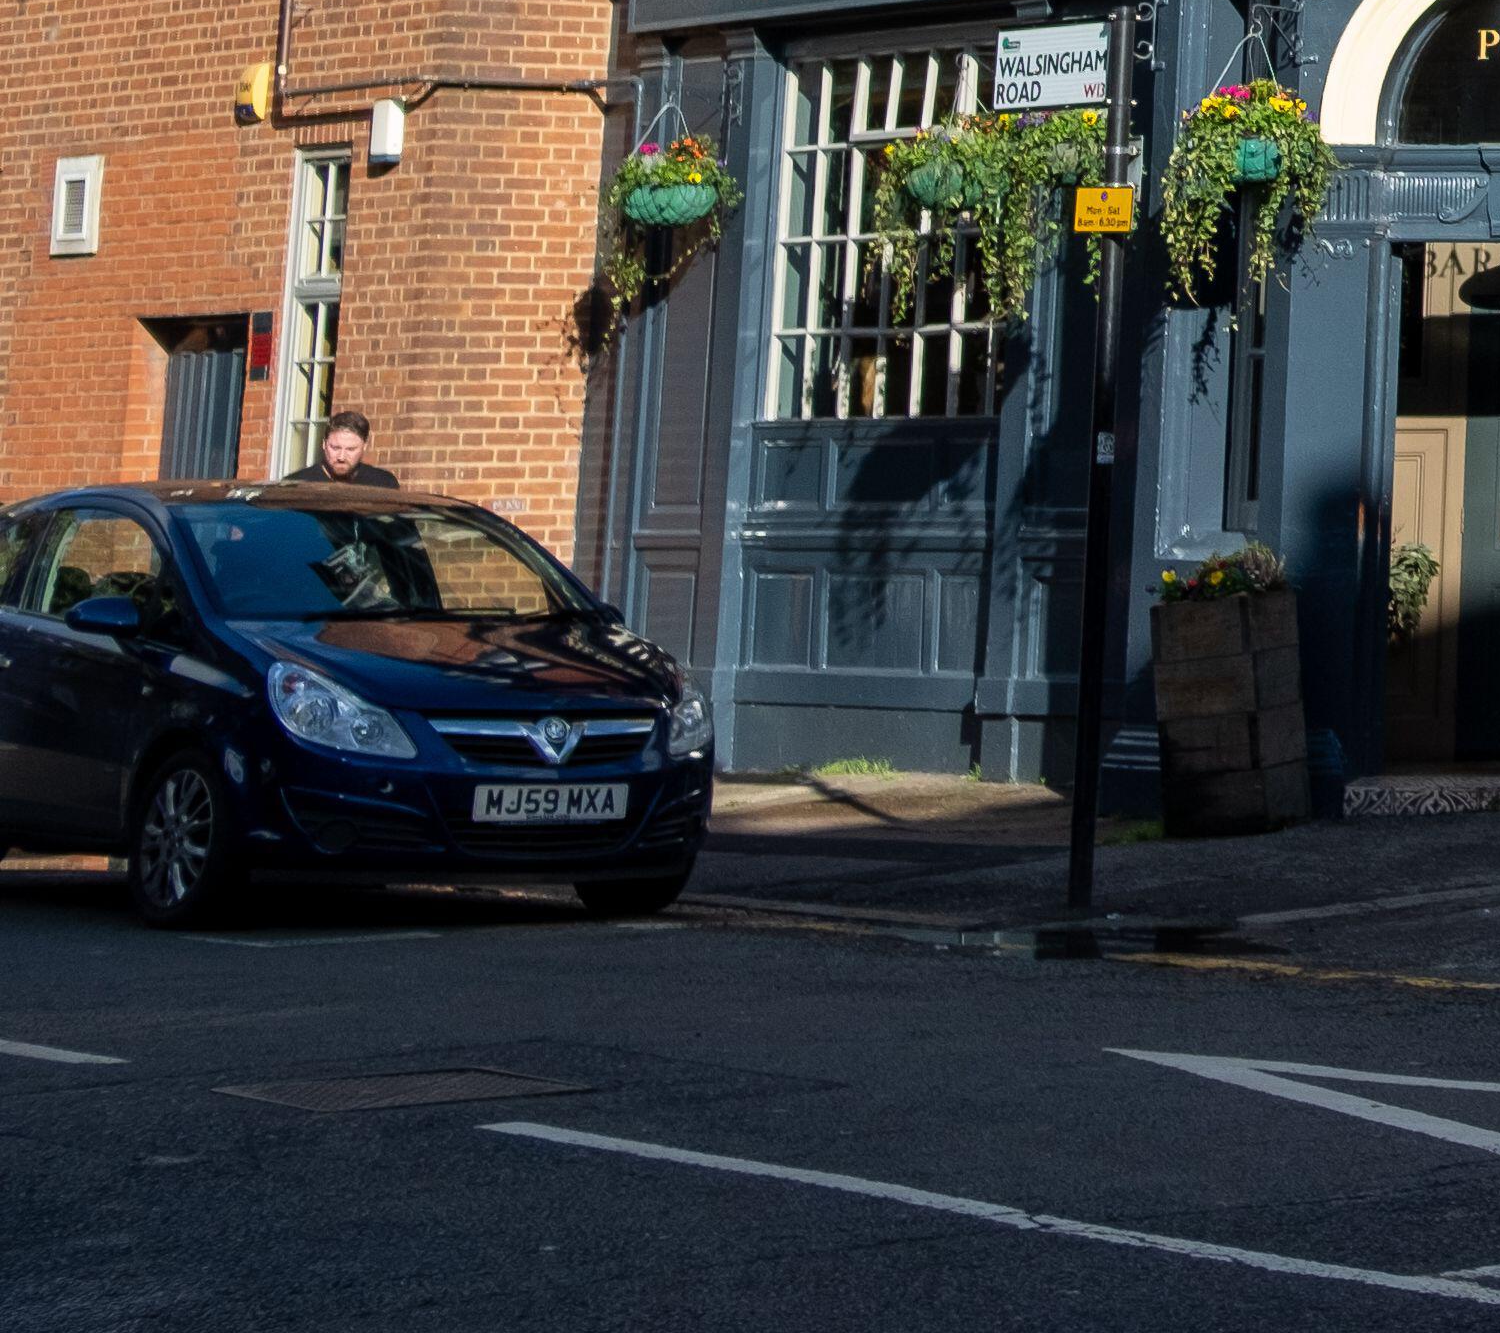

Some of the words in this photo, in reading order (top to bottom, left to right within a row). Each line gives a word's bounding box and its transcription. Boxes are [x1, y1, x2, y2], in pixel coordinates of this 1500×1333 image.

[999, 49, 1107, 79] WALSINGHAM
[996, 80, 1041, 104] ROAD
[485, 788, 560, 816] MJ59
[567, 787, 615, 815] MXA
